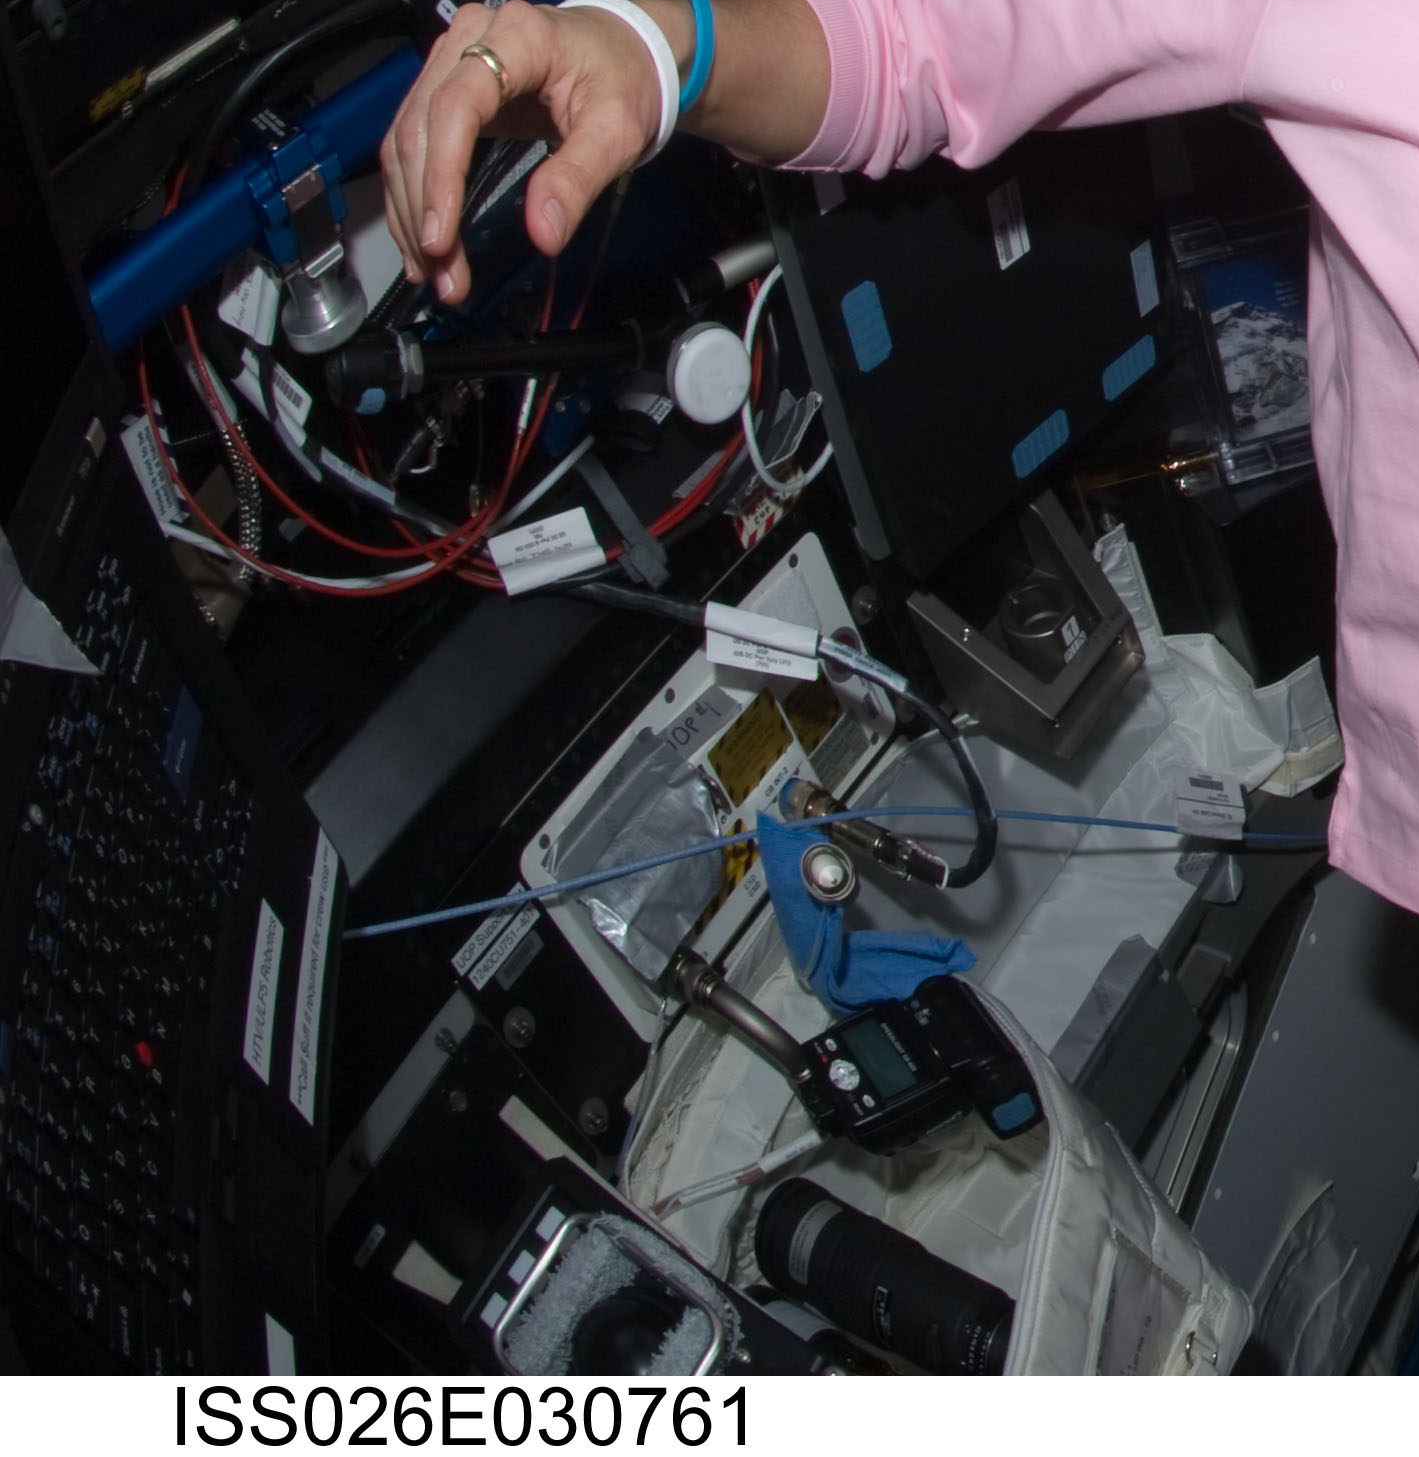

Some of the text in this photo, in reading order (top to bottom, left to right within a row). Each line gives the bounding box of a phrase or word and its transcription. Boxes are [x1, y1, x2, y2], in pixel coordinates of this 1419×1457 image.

[137, 431, 166, 516] Hose is not to be
[139, 426, 173, 508] used as a handle
[260, 917, 281, 981] Robotics
[305, 951, 319, 1012] required
[312, 932, 320, 949] for
[316, 895, 325, 927] crew
[456, 905, 513, 969] UOP Suppor
